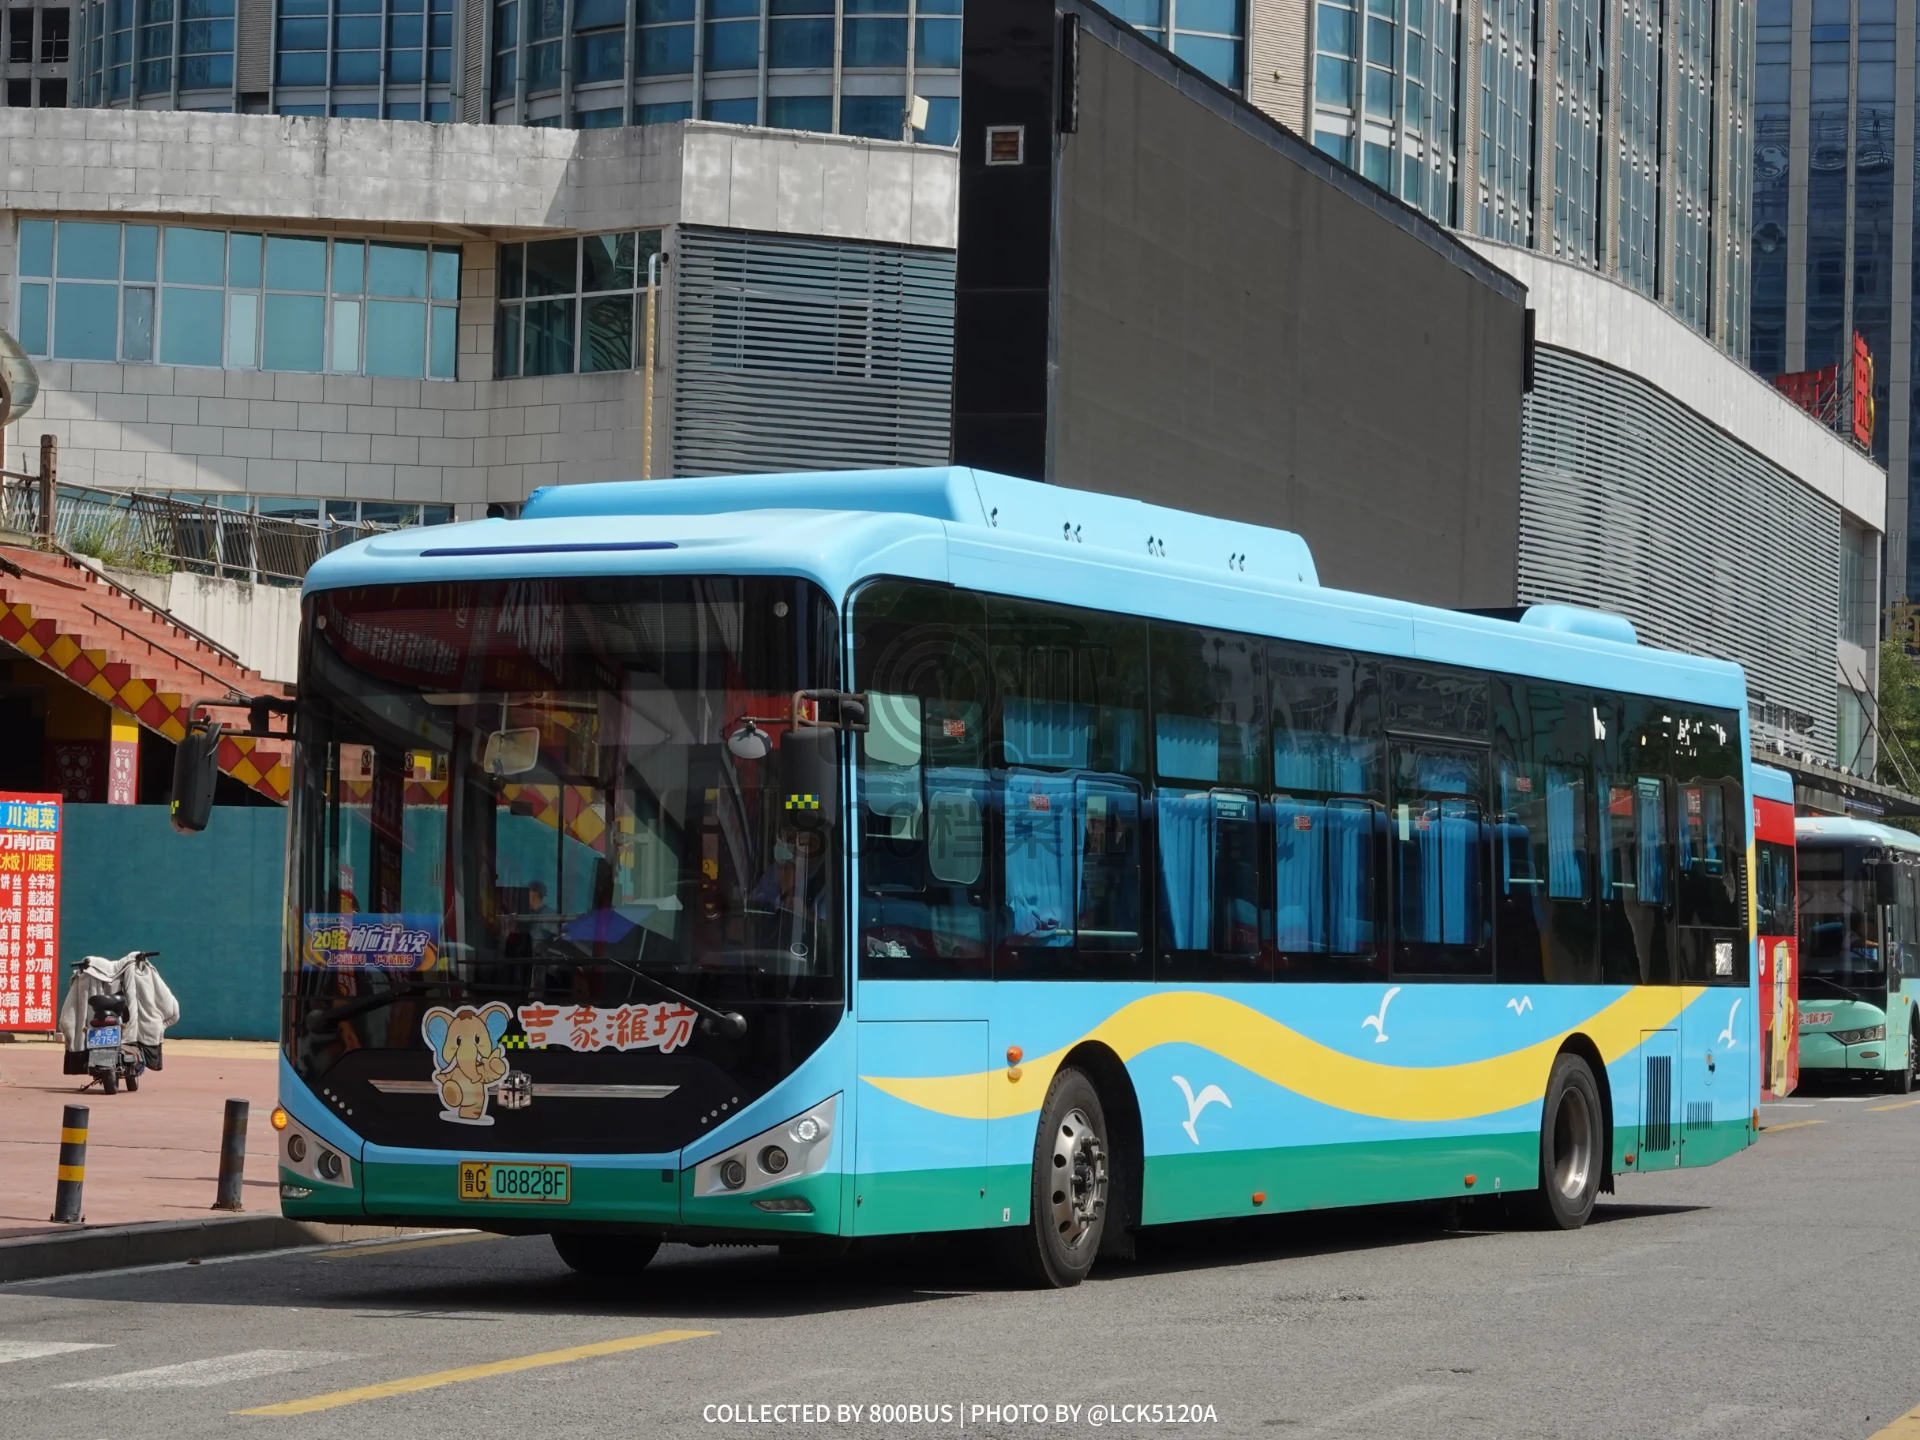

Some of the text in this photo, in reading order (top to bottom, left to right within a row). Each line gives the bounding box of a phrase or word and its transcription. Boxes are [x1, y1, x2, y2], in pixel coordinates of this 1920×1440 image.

[0, 852, 55, 872] 水饺】川湘菜
[27, 873, 55, 889] 全羊汤
[26, 923, 54, 940] 炸酱面
[25, 957, 53, 973] 炒刀削
[24, 1007, 52, 1024] 酸辣粉
